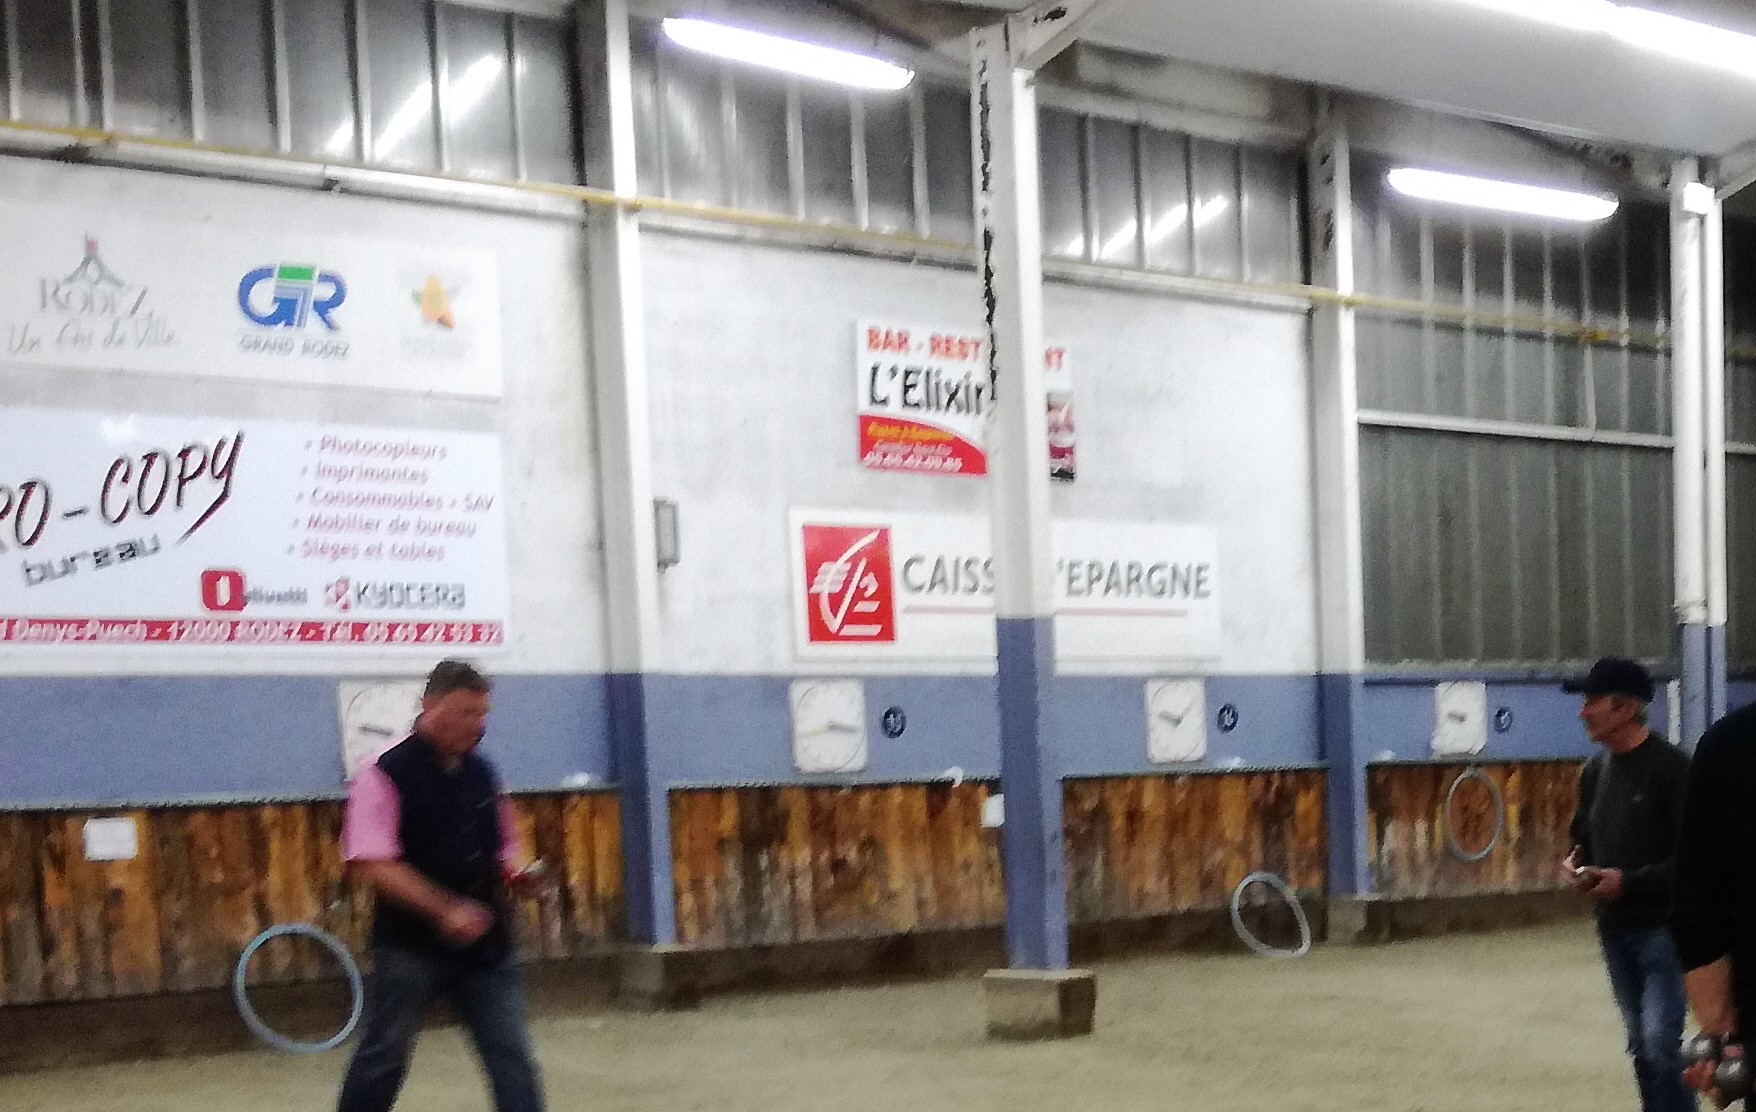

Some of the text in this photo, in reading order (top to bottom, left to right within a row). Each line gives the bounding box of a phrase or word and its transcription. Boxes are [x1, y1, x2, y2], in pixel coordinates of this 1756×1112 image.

[867, 326, 910, 353] BAR
[319, 433, 448, 461] Photocopieurs
[314, 460, 430, 484] Imprimantes
[100, 428, 246, 547] COPY
[309, 486, 496, 513] Consommables SAV
[306, 512, 479, 539] Mobilier de bureau
[362, 541, 385, 562] et
[389, 540, 447, 563] tables
[900, 553, 1213, 601] CAISS 'EPARGNE
